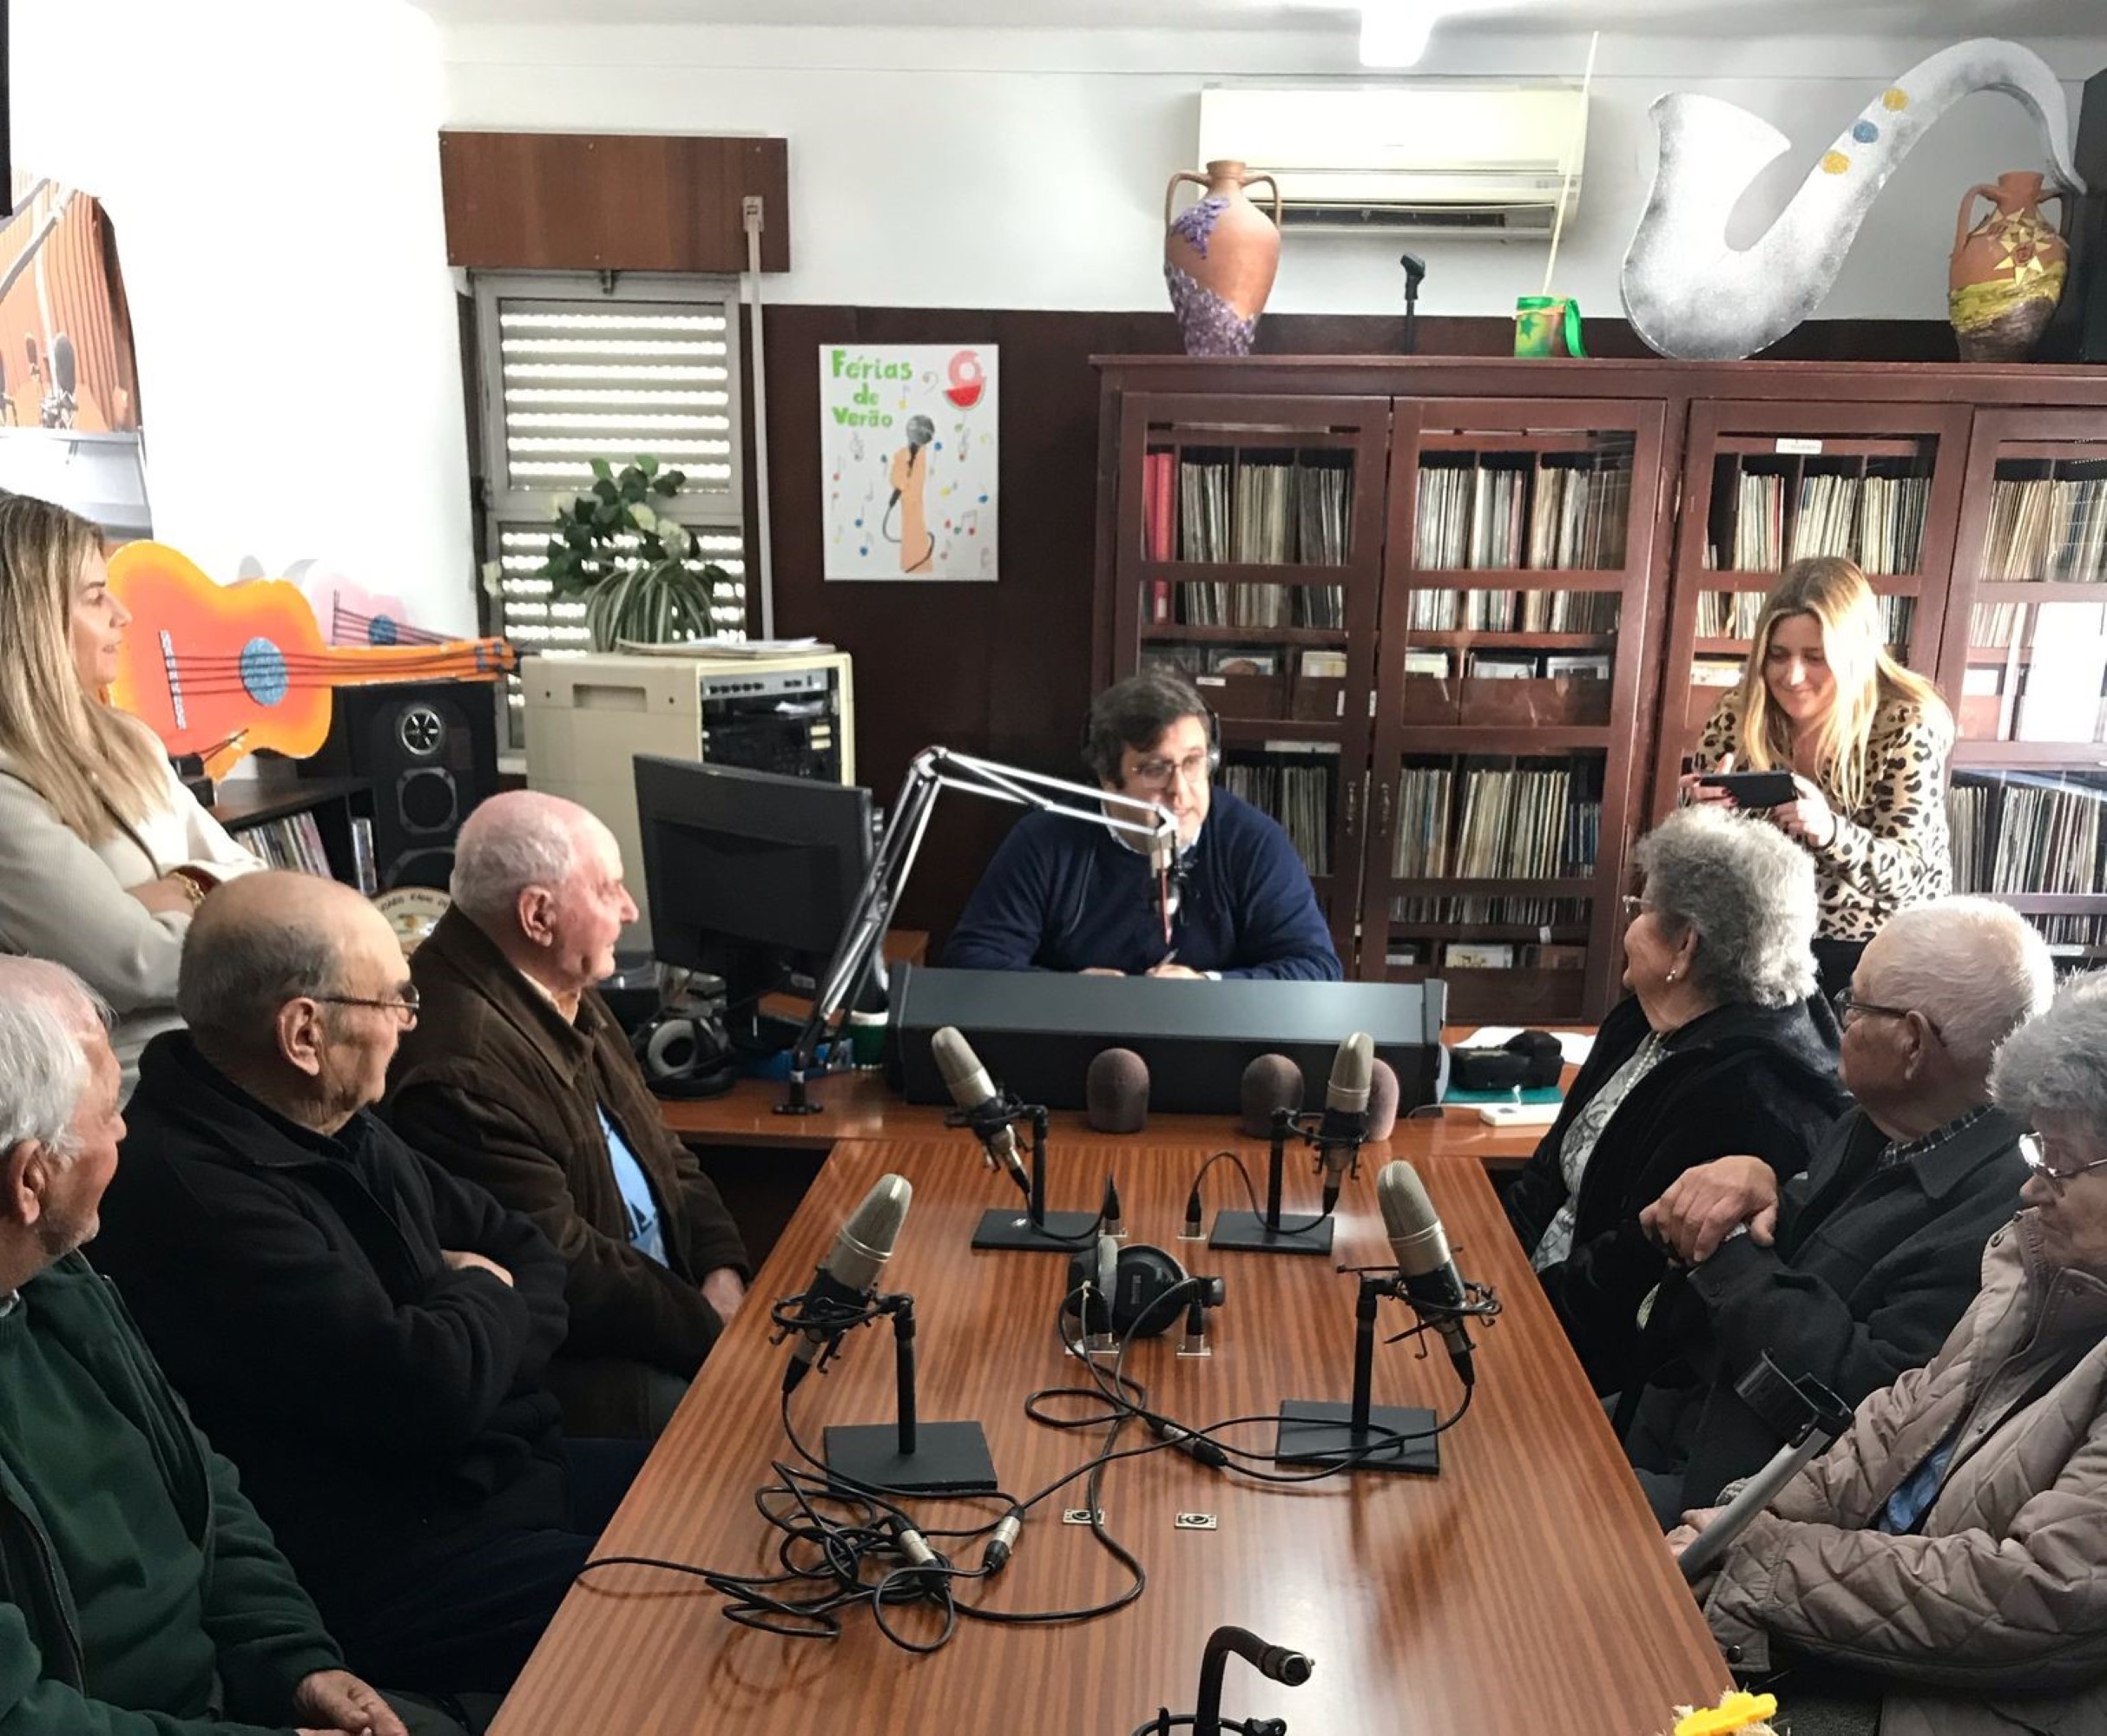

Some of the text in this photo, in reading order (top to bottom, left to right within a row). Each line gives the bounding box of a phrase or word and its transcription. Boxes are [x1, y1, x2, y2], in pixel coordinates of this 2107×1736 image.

[833, 350, 912, 380] Férias
[853, 382, 879, 405] de
[833, 407, 892, 428] Verão
